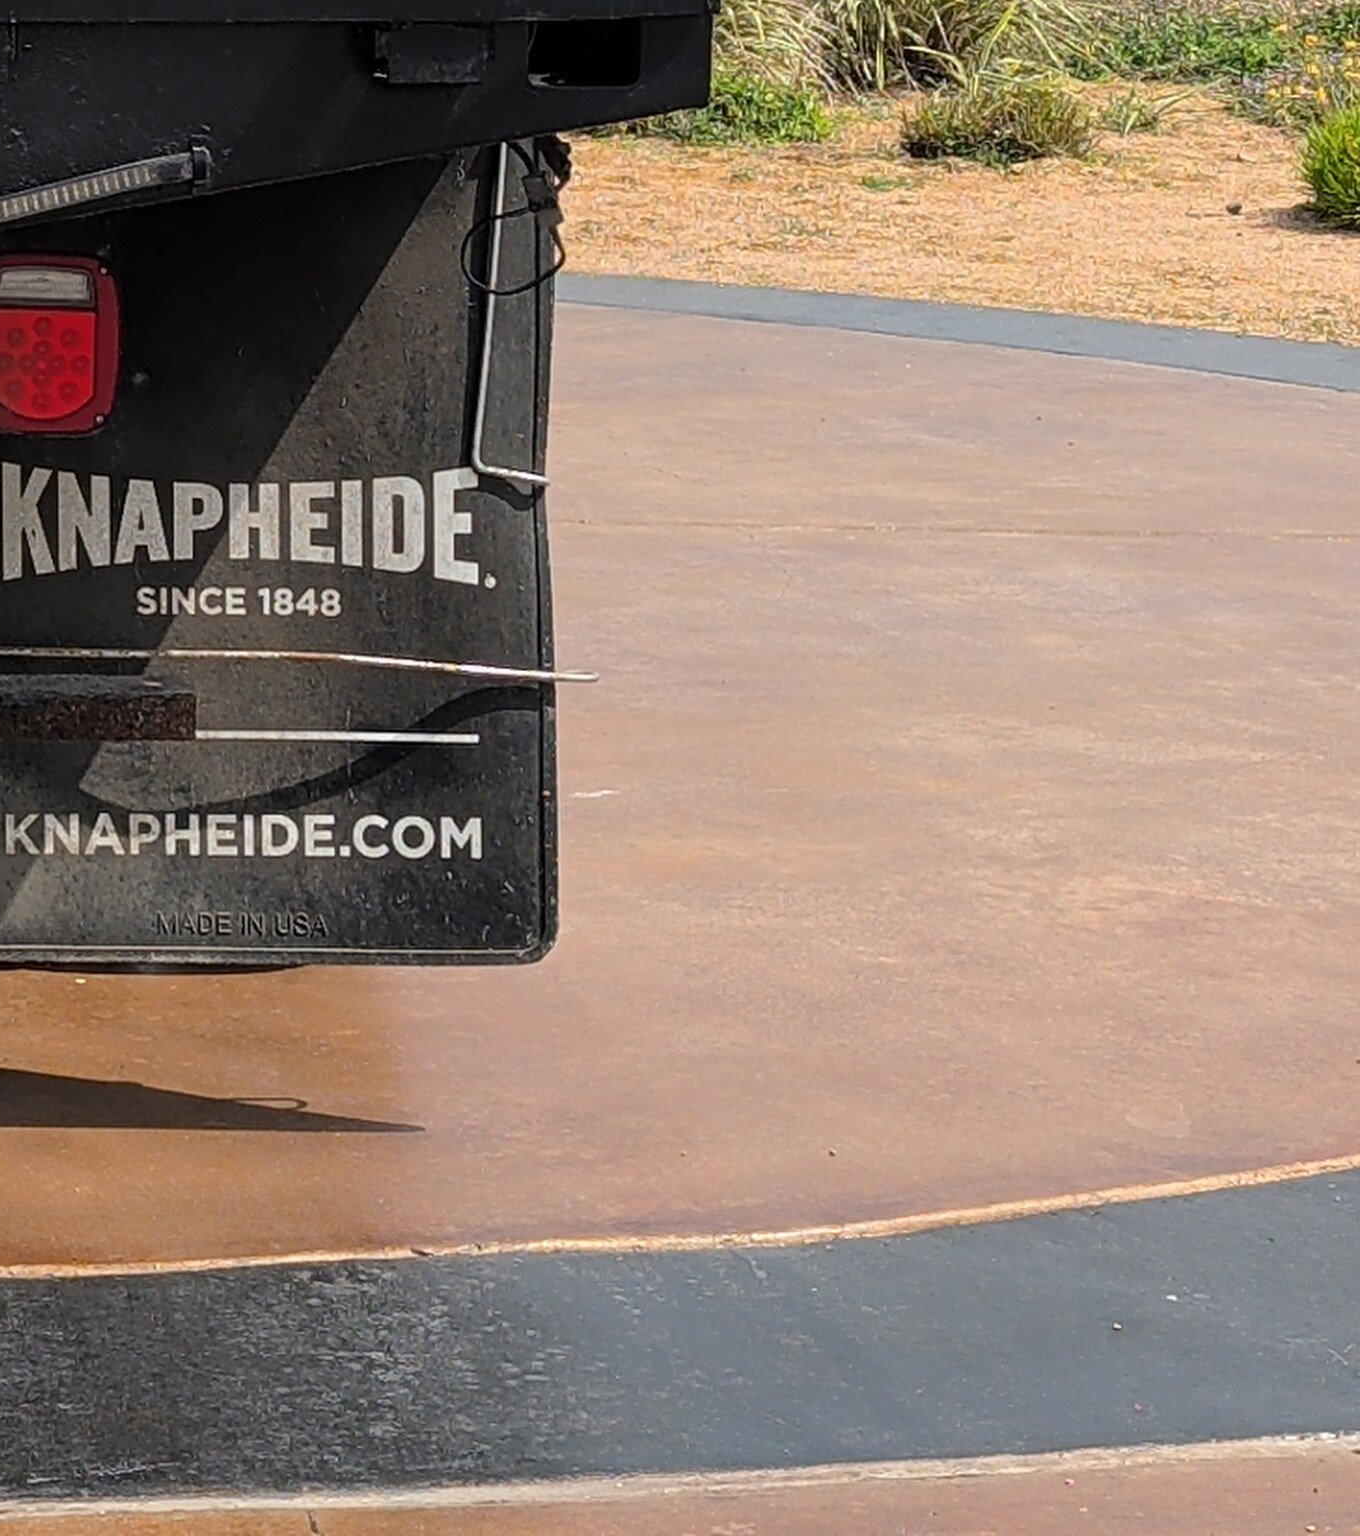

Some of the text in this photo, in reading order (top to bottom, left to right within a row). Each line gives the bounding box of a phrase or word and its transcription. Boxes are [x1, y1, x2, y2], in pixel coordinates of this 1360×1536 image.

[2, 462, 480, 585] KNAPHEIDE
[137, 586, 342, 617] SINCE 1848
[5, 812, 483, 860] KNAPHEIDE.COM
[155, 911, 328, 938] MADE IN USA
